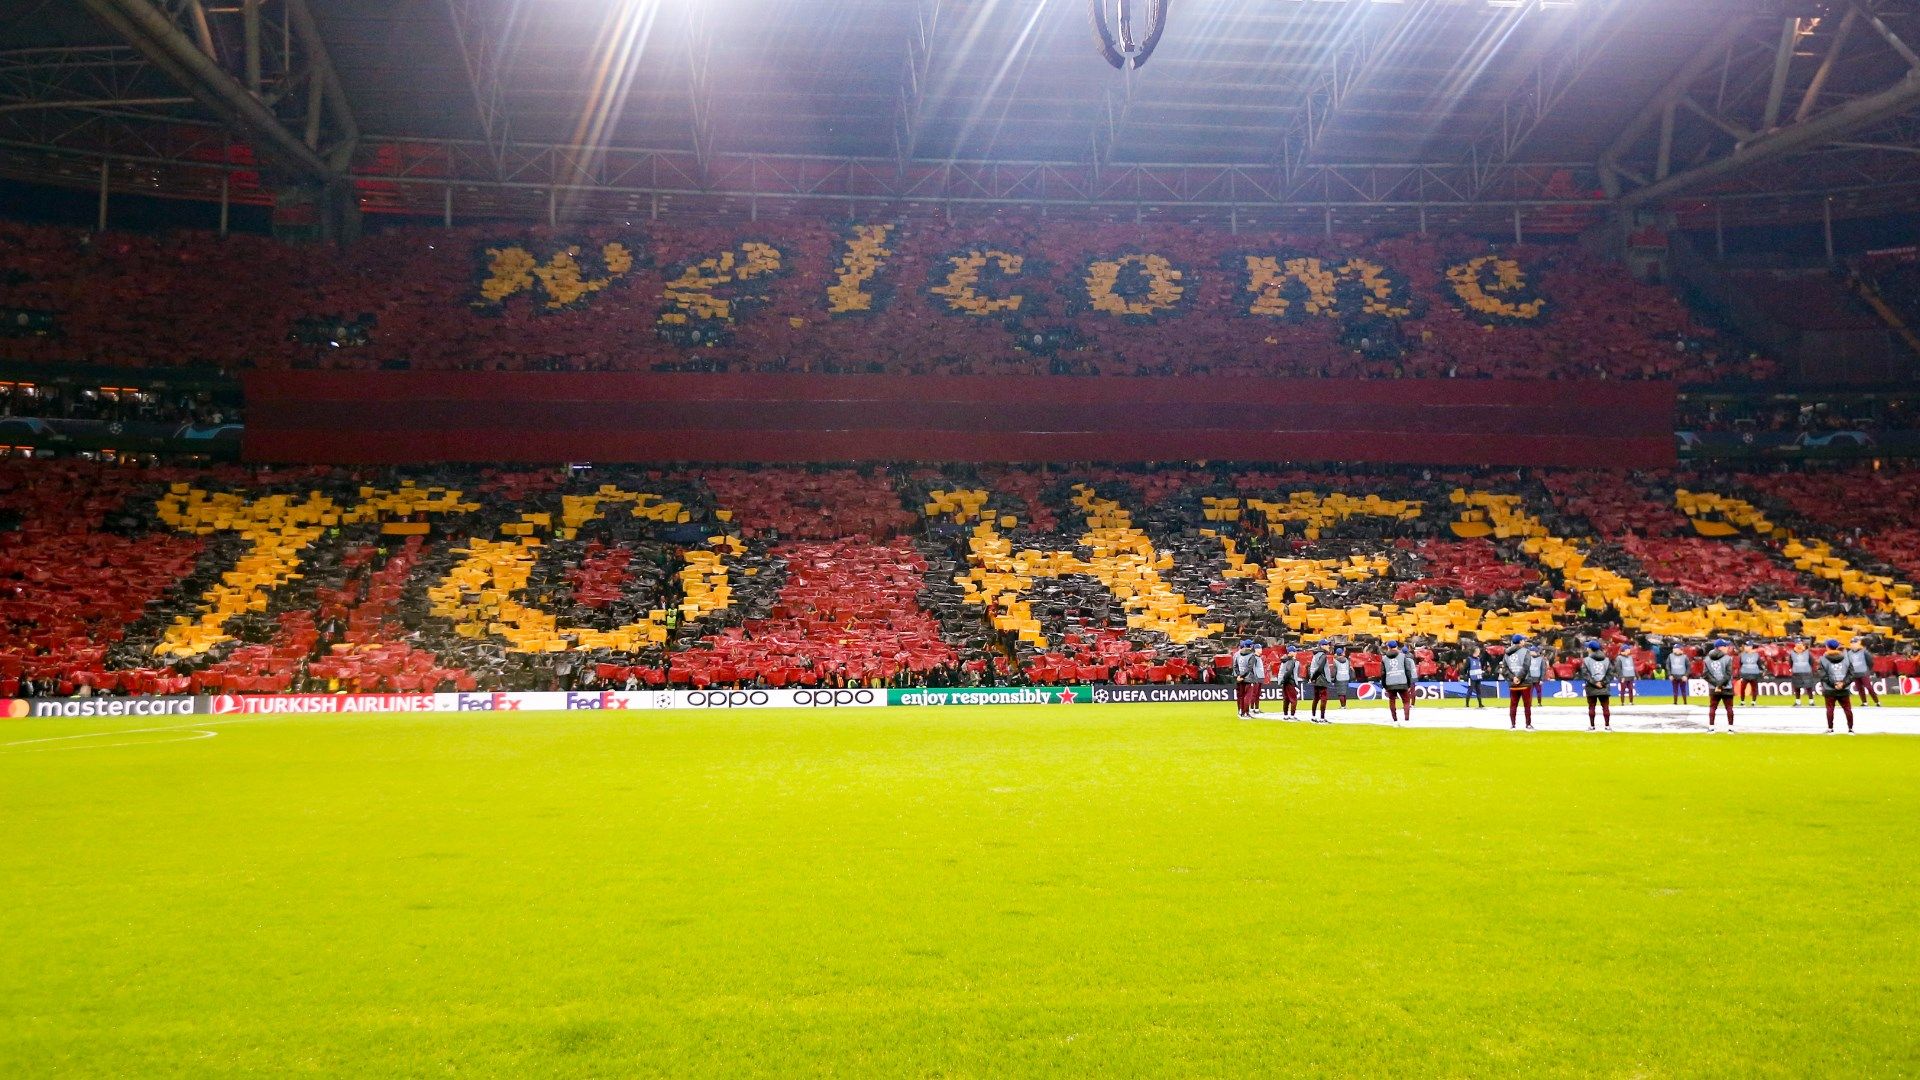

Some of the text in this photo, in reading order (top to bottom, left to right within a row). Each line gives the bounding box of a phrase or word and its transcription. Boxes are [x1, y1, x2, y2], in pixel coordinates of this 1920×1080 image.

[458, 692, 521, 711] FedEx
[567, 691, 629, 710] FedEx
[687, 691, 769, 708] oppo
[793, 690, 874, 707] oppo
[901, 688, 1051, 705] enjoy responsibly
[1112, 689, 1147, 702] UEFA
[1150, 688, 1229, 702] CHAMPIONS
[37, 696, 195, 717] mastercard
[245, 695, 434, 713] TURKISH AIRLINES
